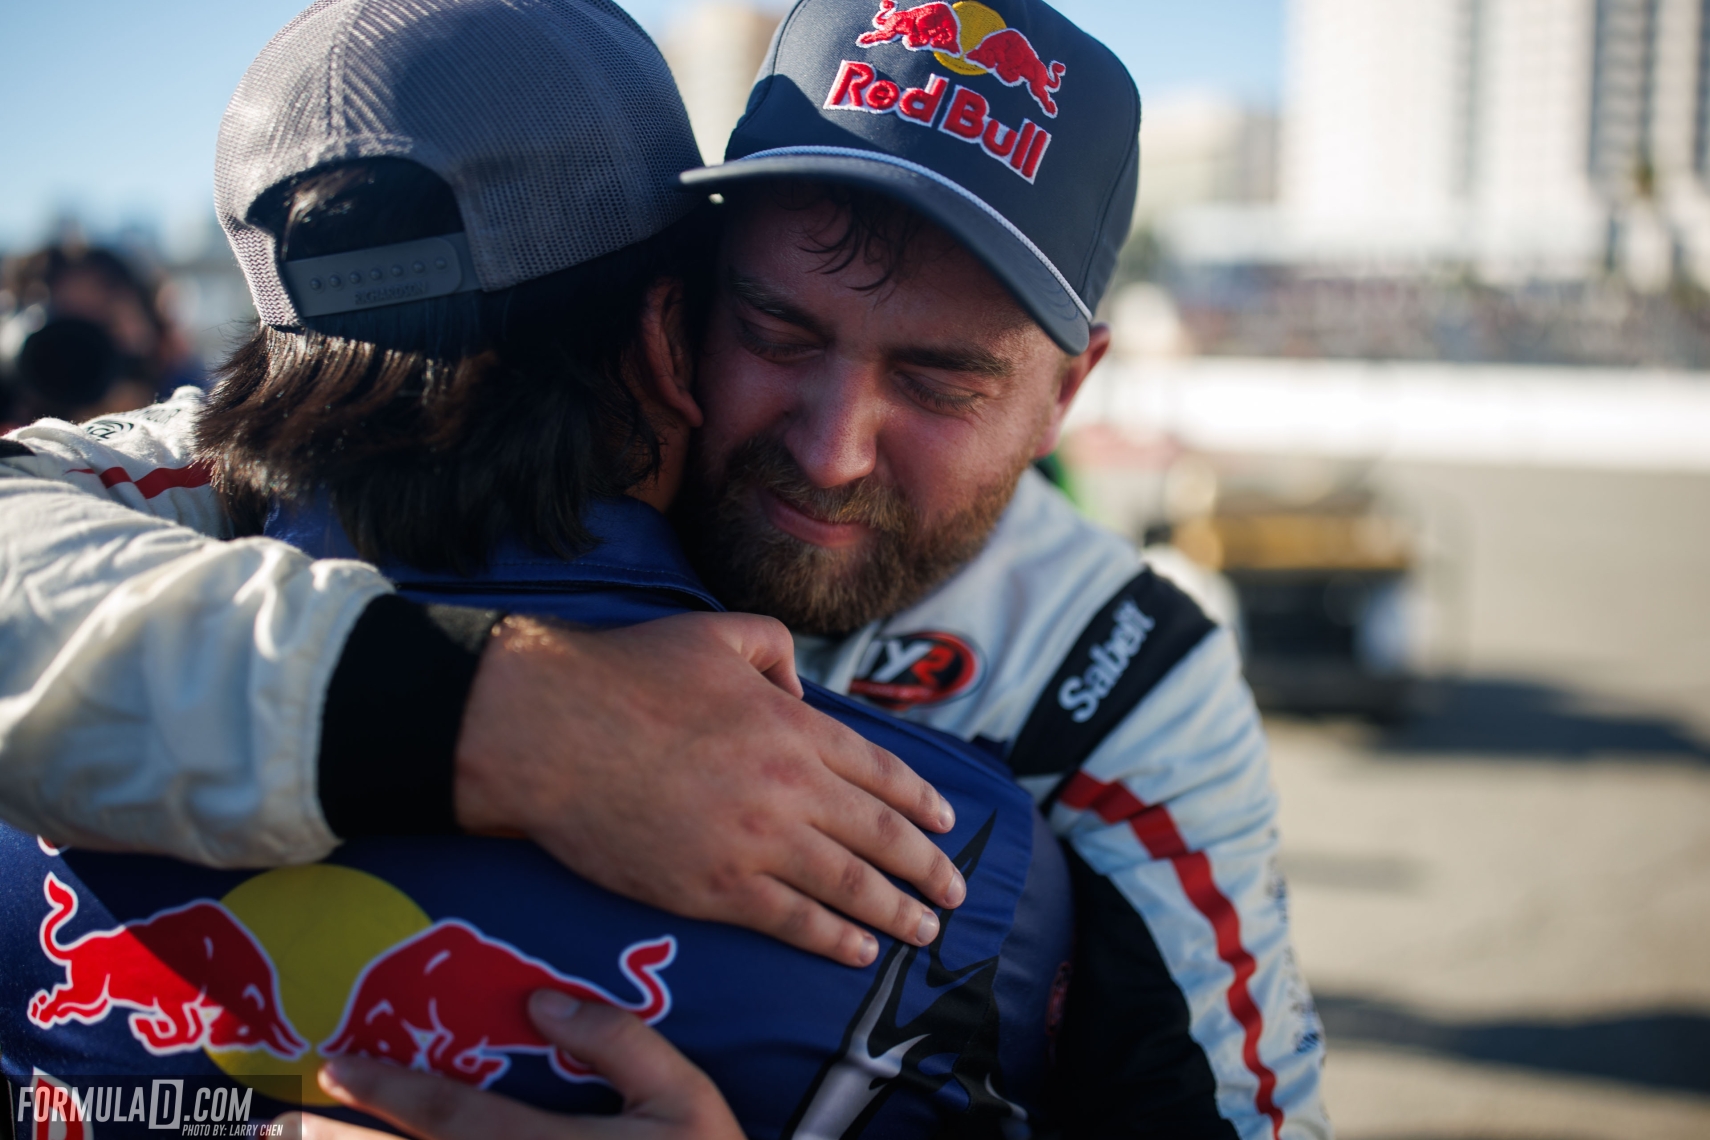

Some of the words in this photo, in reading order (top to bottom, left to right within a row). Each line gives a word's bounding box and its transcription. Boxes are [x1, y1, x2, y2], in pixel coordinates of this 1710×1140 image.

[824, 60, 949, 127] Red
[938, 85, 1051, 185] Bull
[1058, 599, 1155, 723] Sabelt
